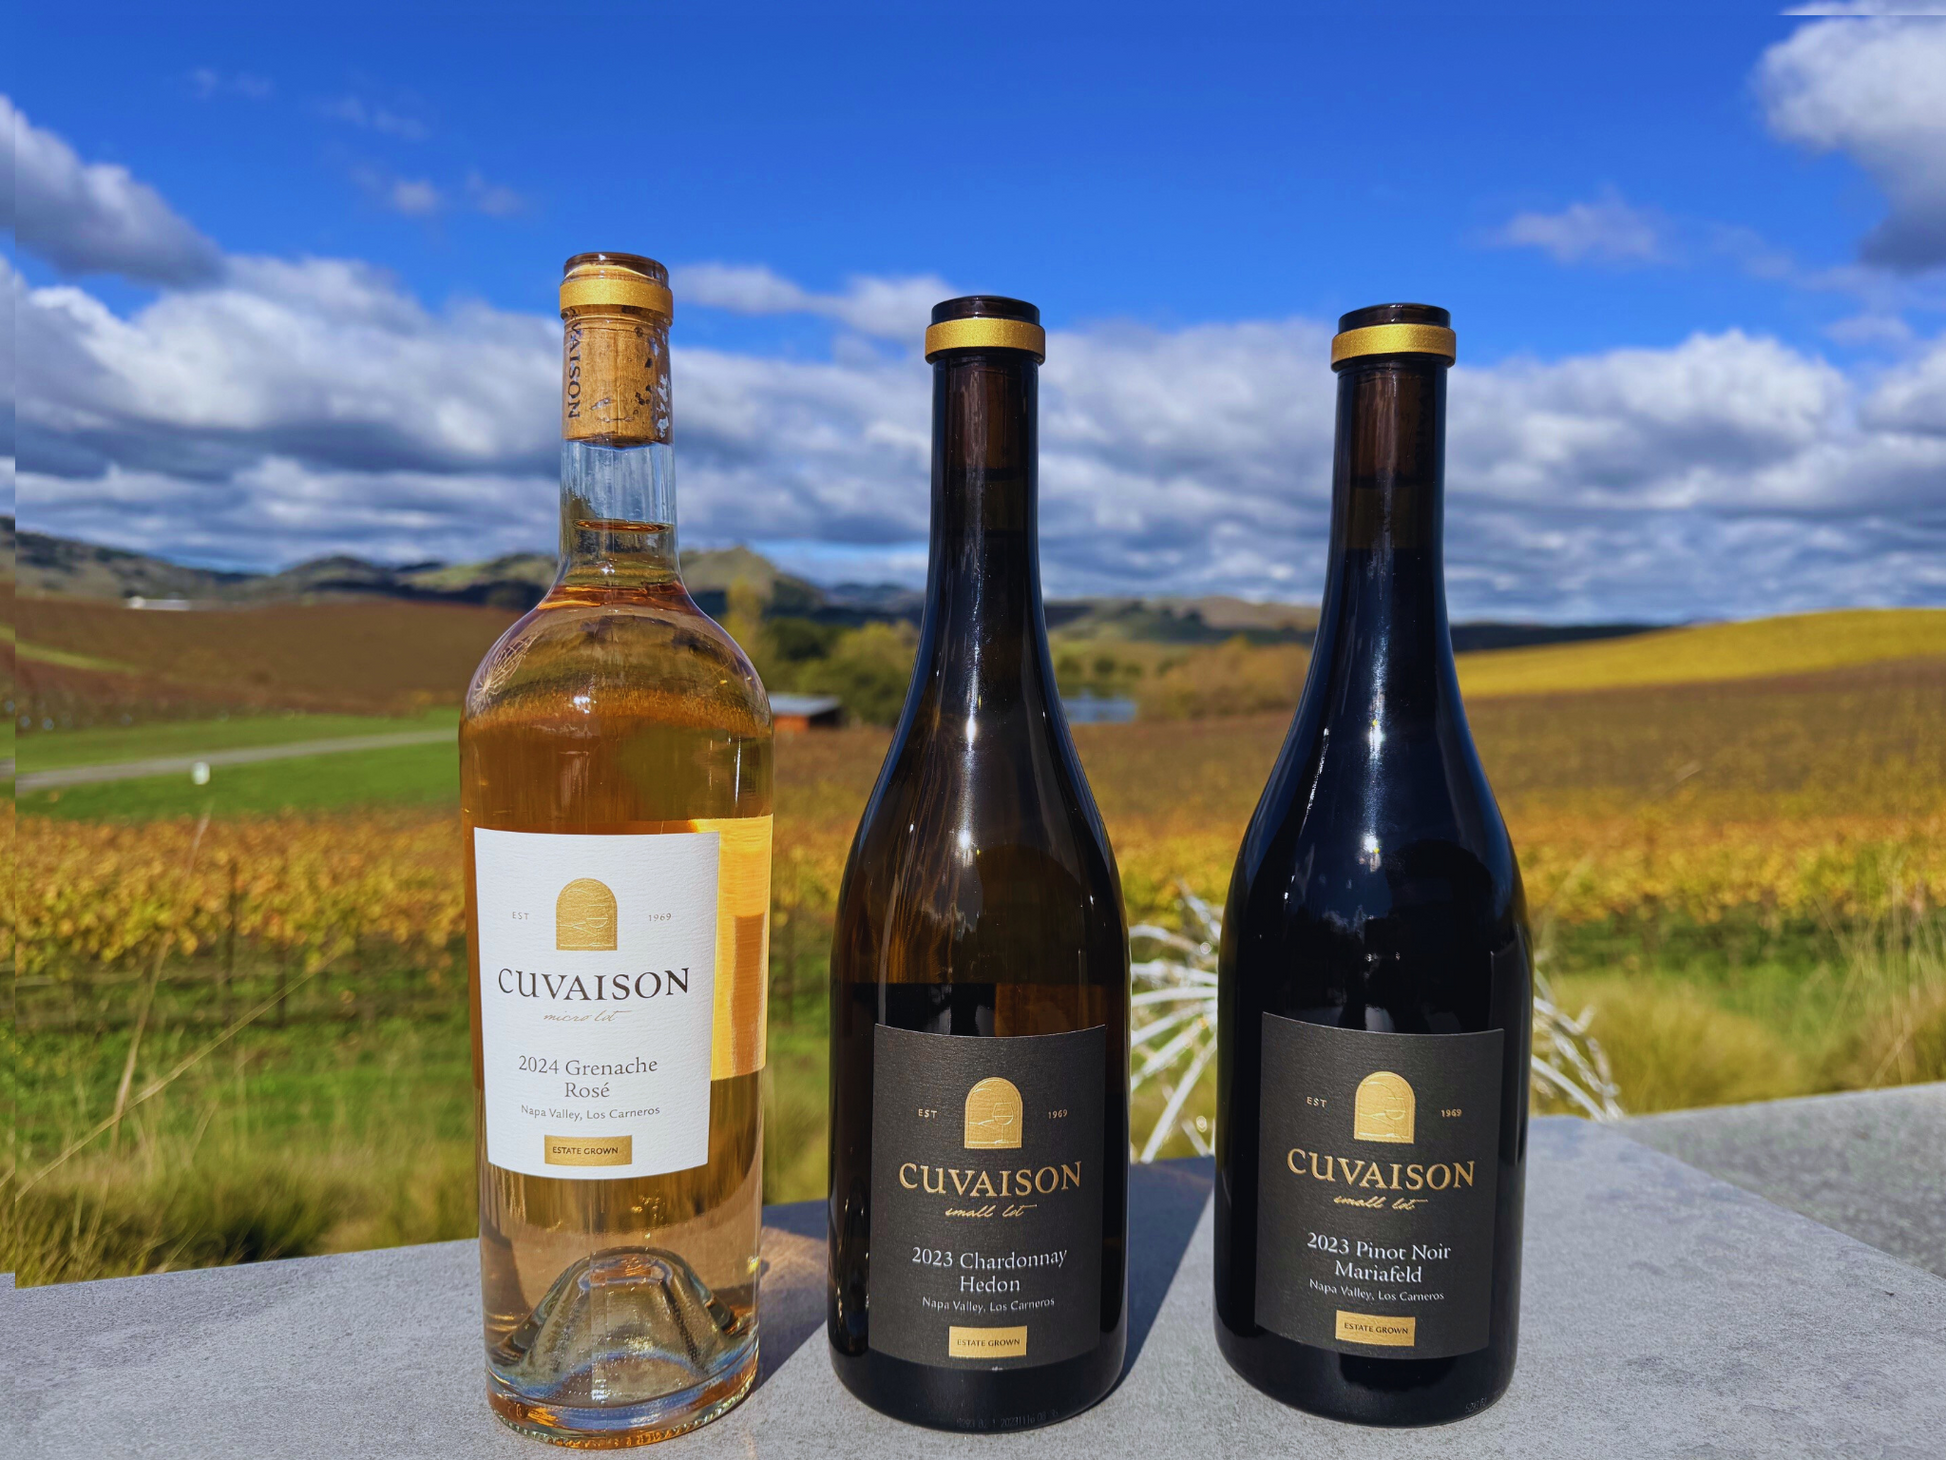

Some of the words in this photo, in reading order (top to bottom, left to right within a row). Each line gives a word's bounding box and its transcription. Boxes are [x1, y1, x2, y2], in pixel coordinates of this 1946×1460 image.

[567, 307, 582, 418] VAISON
[512, 912, 529, 920] EST
[648, 912, 672, 922] 1969
[498, 968, 689, 1001] CUVAISON
[543, 1010, 591, 1022] micro
[593, 1010, 633, 1022] lot
[518, 1055, 559, 1075] 2024
[565, 1057, 658, 1076] Grenache
[564, 1082, 610, 1098] Rosé
[521, 1105, 546, 1118] Napa
[549, 1108, 582, 1122] Valley,
[587, 1109, 605, 1119] Los
[609, 1106, 660, 1119] Carneros
[918, 1109, 938, 1118] EST
[1048, 1109, 1068, 1119] 1969
[1306, 1096, 1327, 1108] EST
[1441, 1108, 1462, 1118] 1969
[552, 1147, 581, 1155] ESTATE
[584, 1147, 618, 1155] GROWN
[1287, 1148, 1475, 1191] CUVAISON
[899, 1161, 1081, 1197] CUVAISON
[944, 1204, 996, 1218] small
[1002, 1204, 1037, 1217] lot
[1333, 1196, 1384, 1209] small
[1333, 1195, 1386, 1210] lot
[1307, 1232, 1349, 1254] 2023
[1356, 1241, 1405, 1260] Pinot
[1412, 1244, 1451, 1259] Noir
[912, 1247, 953, 1267] 2023
[960, 1249, 1067, 1270] Chardonnay
[1335, 1260, 1422, 1283] Mariafeld
[960, 1276, 1020, 1292] Hedon
[1309, 1278, 1337, 1295] Napa
[1340, 1285, 1374, 1301] Valley,
[1378, 1290, 1396, 1301] Los
[1400, 1290, 1444, 1301] Carneros
[923, 1296, 950, 1311] Napa
[953, 1299, 986, 1314] Valley,
[989, 1301, 1007, 1312] Los
[1010, 1298, 1055, 1311] Carneros
[1344, 1322, 1373, 1332] ESTATE
[1376, 1326, 1408, 1335] GROWN
[957, 1338, 986, 1347] ESTATE
[988, 1338, 1020, 1347] GROWN
